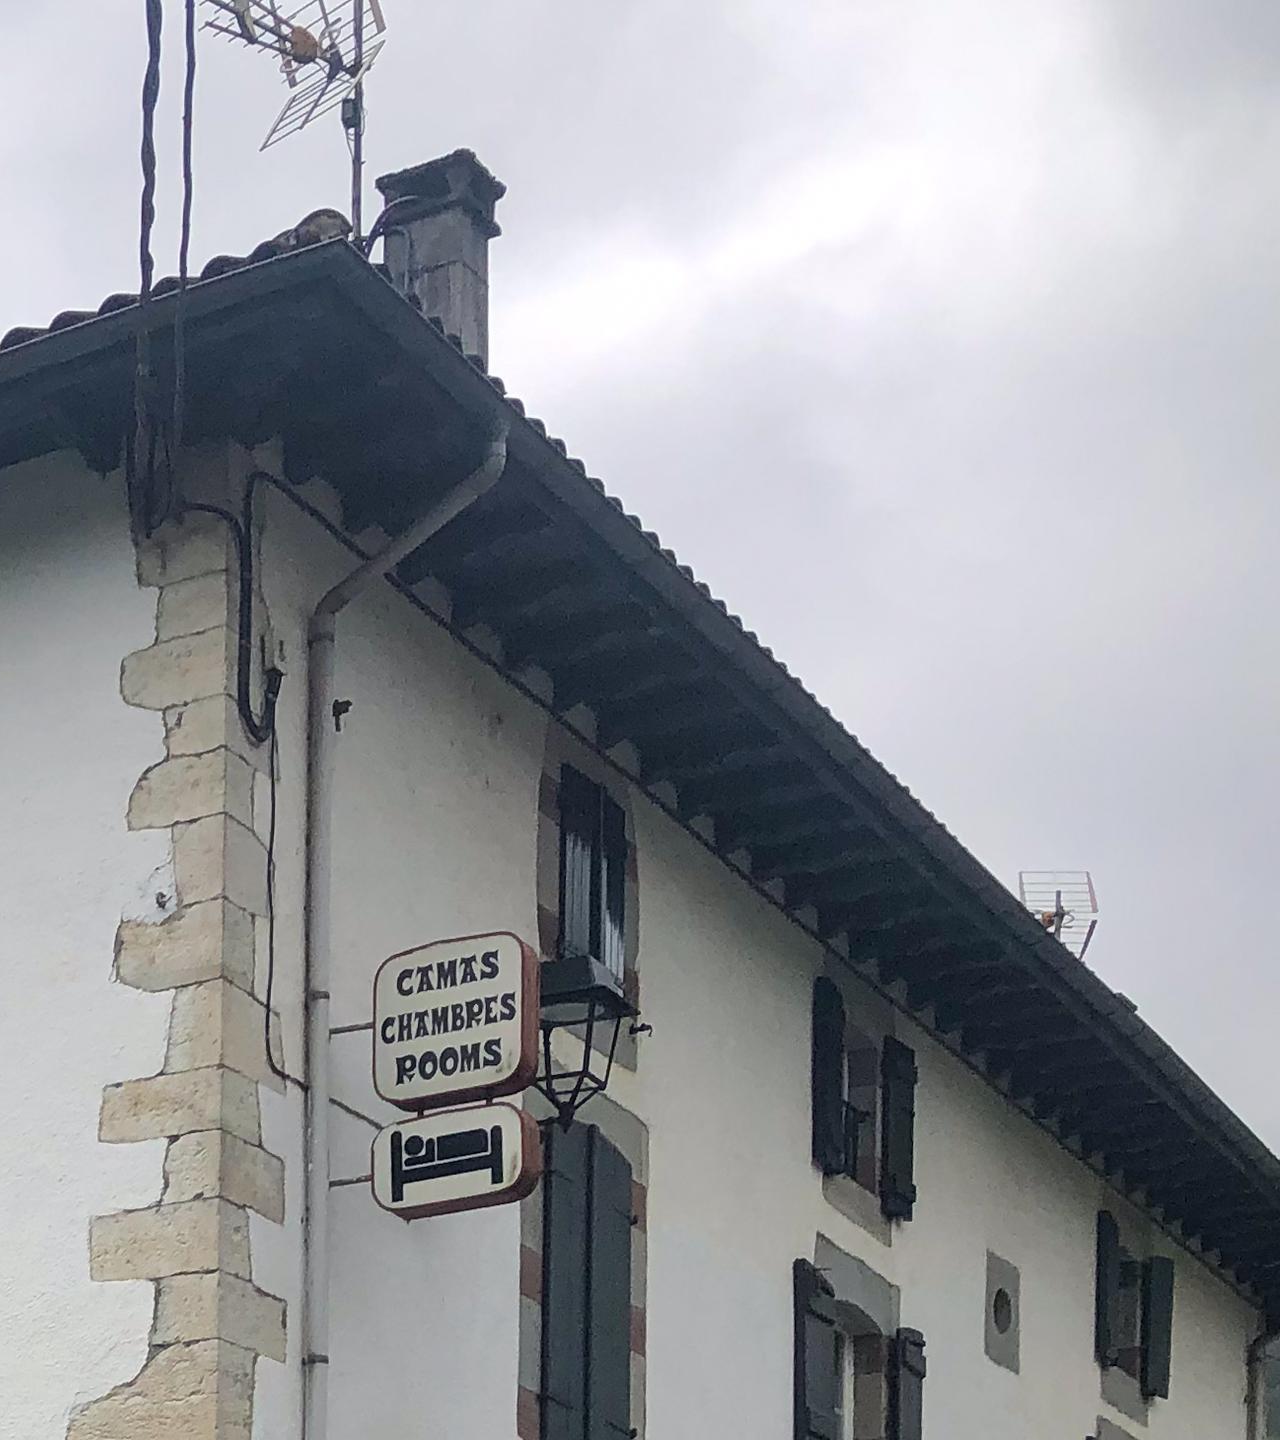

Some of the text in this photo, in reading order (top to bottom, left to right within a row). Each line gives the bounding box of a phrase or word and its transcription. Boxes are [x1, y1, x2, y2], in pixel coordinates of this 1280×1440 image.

[396, 950, 500, 997] CAMAS
[381, 991, 517, 1045] CHAMBRES
[395, 1038, 502, 1086] ROOMS
